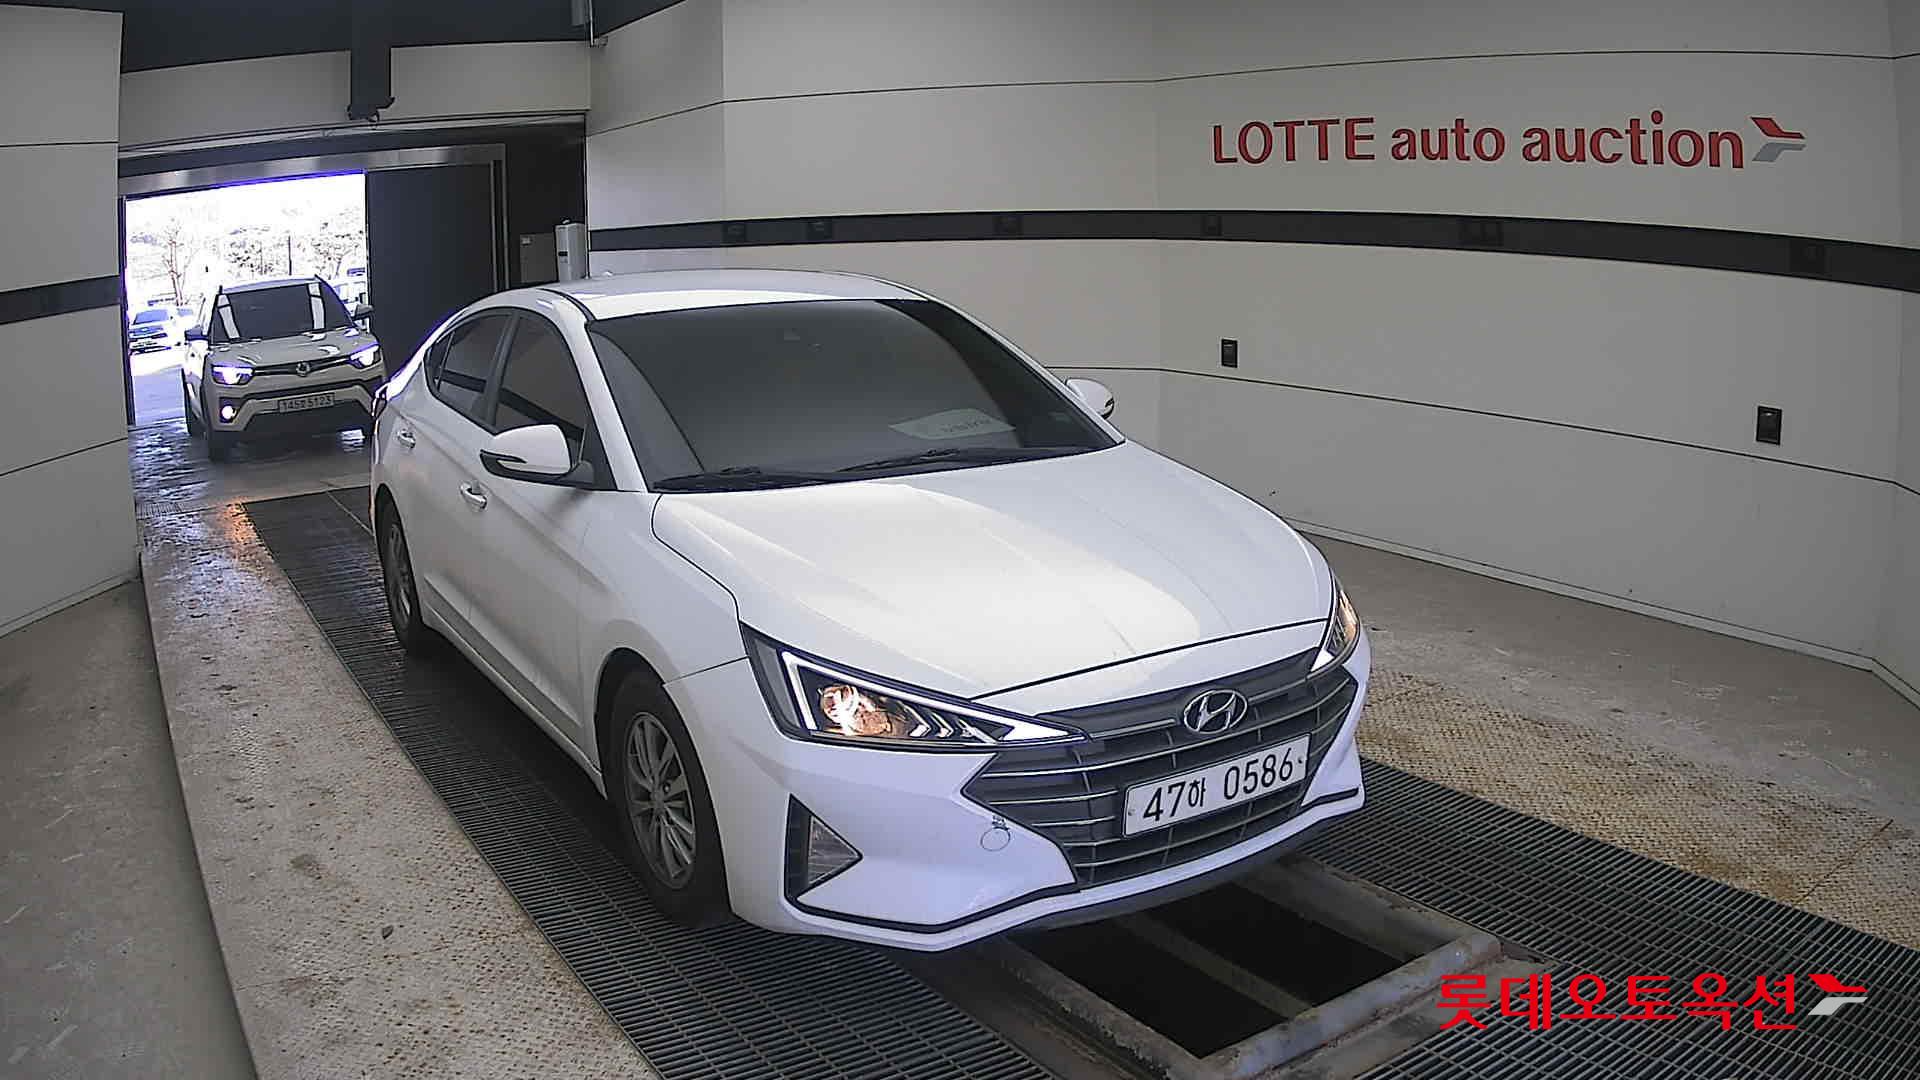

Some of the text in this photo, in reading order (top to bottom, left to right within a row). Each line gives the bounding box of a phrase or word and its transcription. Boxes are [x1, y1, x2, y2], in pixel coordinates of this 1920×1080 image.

[1212, 110, 1744, 168] LOTTE auto auction
[1143, 747, 1294, 822] 47하 0586
